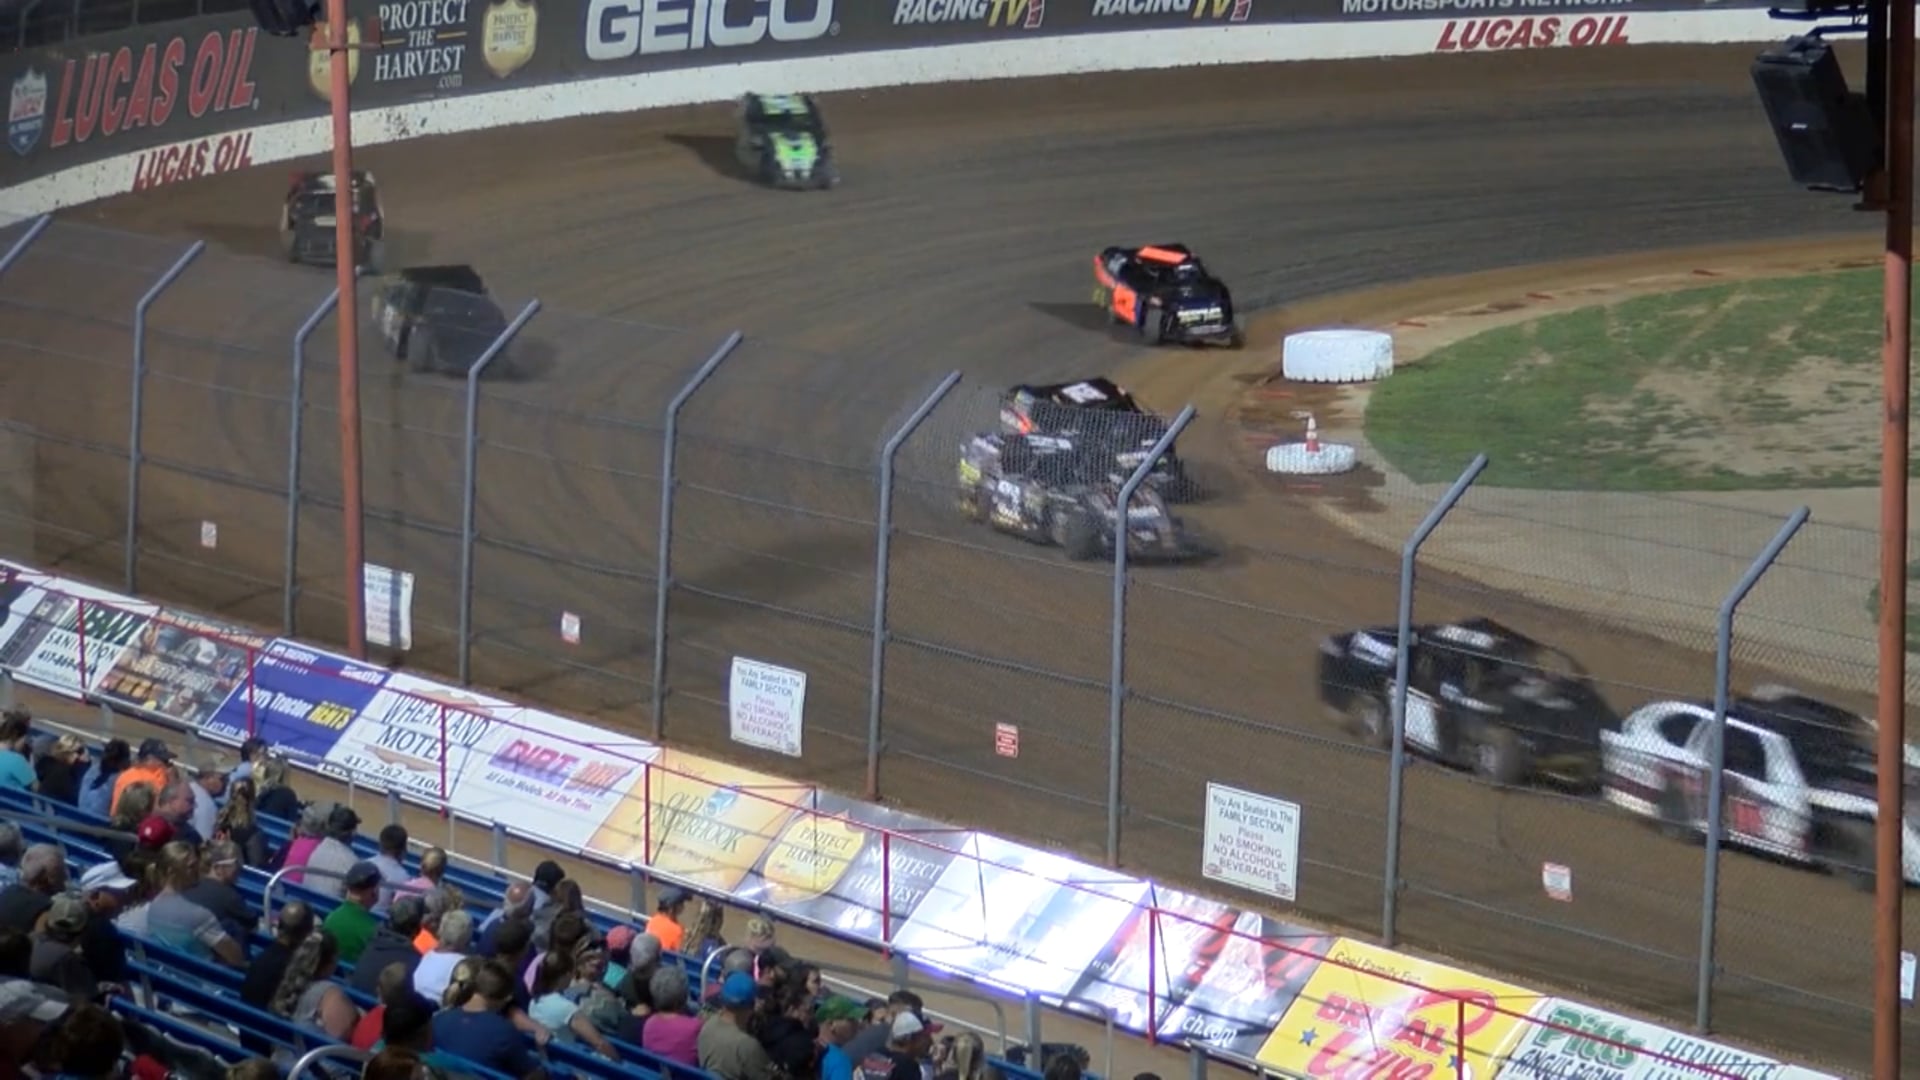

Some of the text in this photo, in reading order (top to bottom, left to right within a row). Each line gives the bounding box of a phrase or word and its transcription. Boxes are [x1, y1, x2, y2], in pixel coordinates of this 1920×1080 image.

[379, 0, 470, 31] PROTECT
[586, 0, 834, 61] GEICO
[408, 29, 435, 48] THE
[1436, 16, 1629, 52] LUCAS OIL
[374, 45, 466, 81] HARVEST
[50, 36, 184, 148] LUCAS
[189, 27, 258, 118] OIL
[132, 131, 252, 191] LUCAS OIL
[45, 630, 118, 662] SANIATION
[380, 691, 491, 748] WHEAAND
[495, 737, 581, 779] DIRT
[1212, 794, 1227, 806] You
[1227, 798, 1241, 810] Are
[1243, 801, 1269, 817] Seated
[1280, 810, 1294, 824] The
[1219, 807, 1285, 834] FAMILY SECTION
[799, 825, 852, 851] PROTECT
[1218, 832, 1283, 859] NO SMOKING
[785, 844, 834, 870] HARVEST
[1212, 844, 1228, 856] NO
[1229, 847, 1288, 873] ALCOHOLIC
[1218, 857, 1280, 882] BEVERAGES
[854, 874, 922, 905] HAVEST
[1315, 991, 1450, 1057] BRAL
[1532, 1004, 1646, 1071] Pitts
